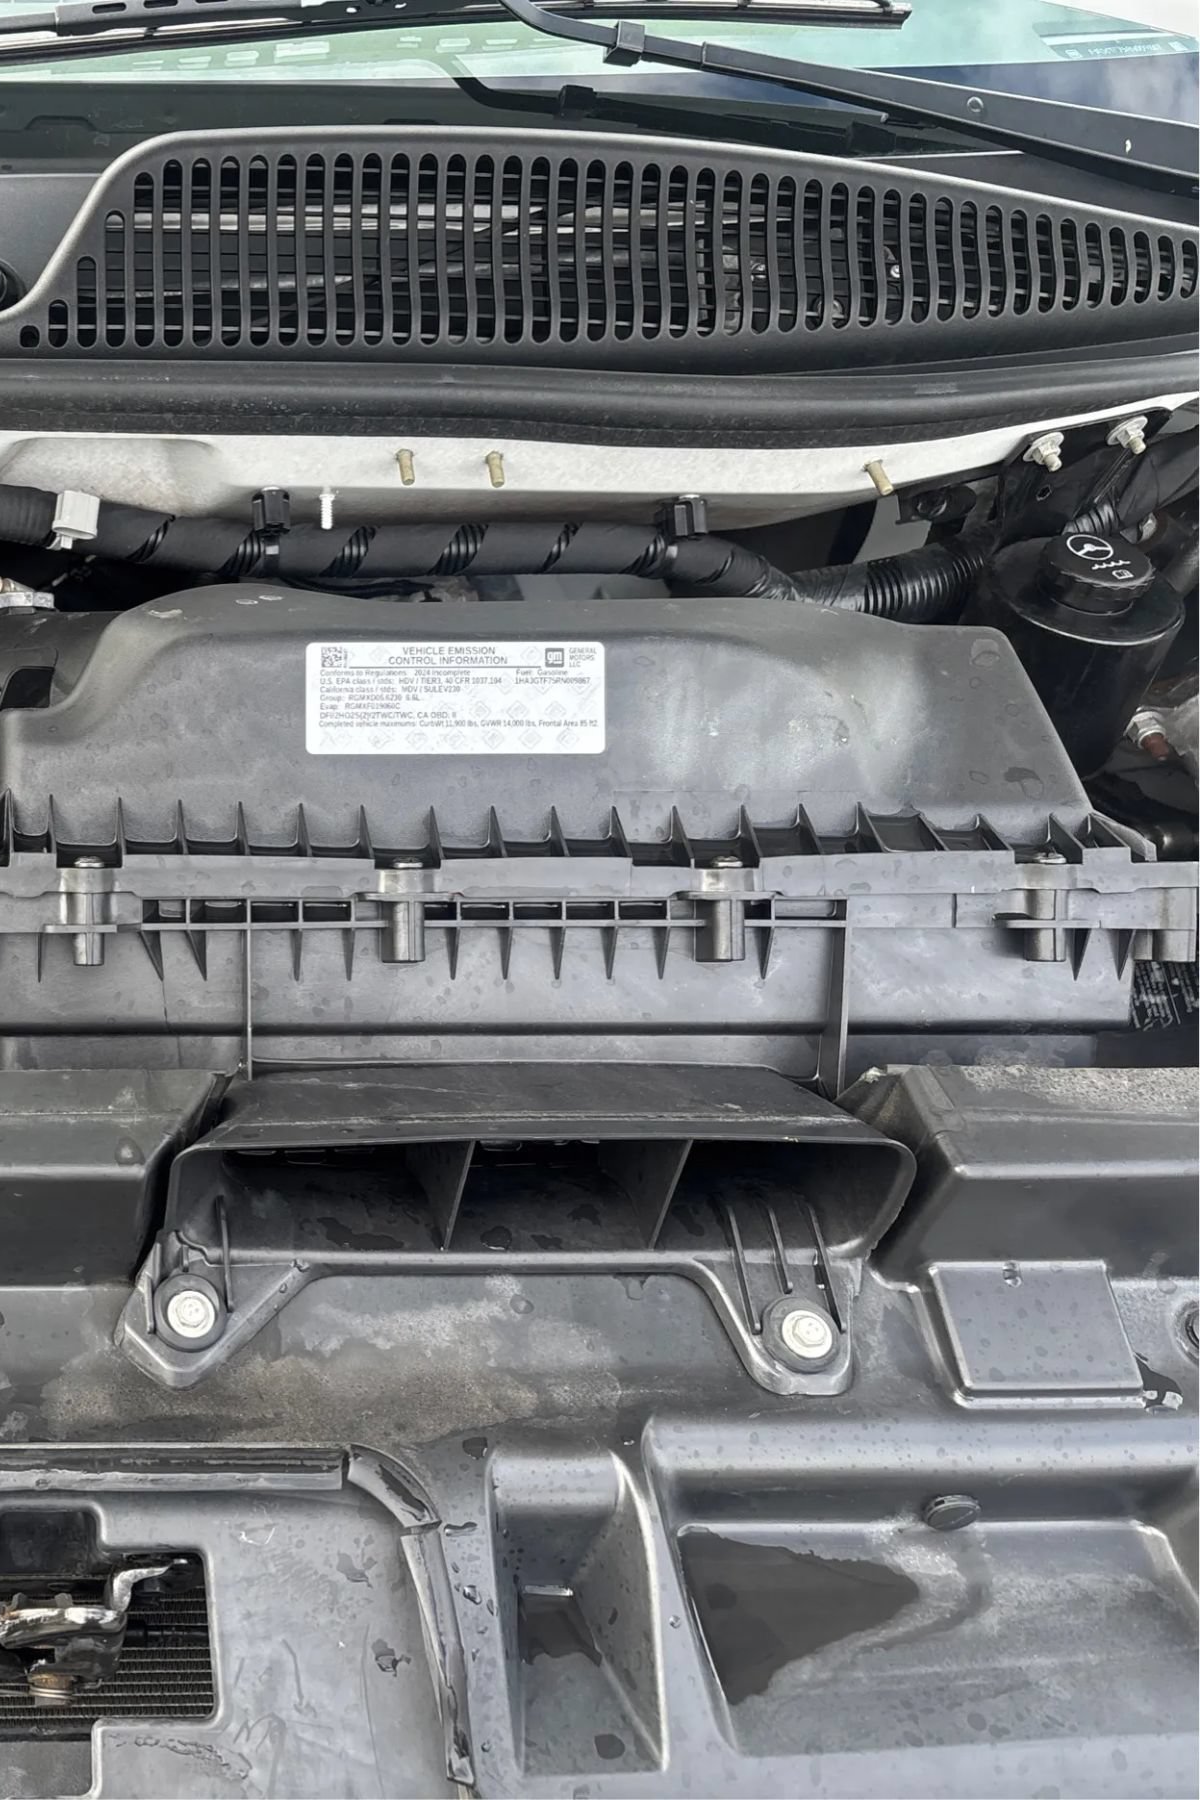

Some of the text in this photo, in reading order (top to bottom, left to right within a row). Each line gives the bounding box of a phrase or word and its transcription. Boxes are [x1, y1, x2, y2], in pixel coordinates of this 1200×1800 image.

[402, 646, 496, 656] VEHICLE EMISSION
[388, 655, 508, 666] CONTROL INFORMATION
[336, 677, 350, 685] EPA
[455, 677, 470, 685] CFR
[417, 711, 428, 719] CA
[318, 720, 354, 729] Completed
